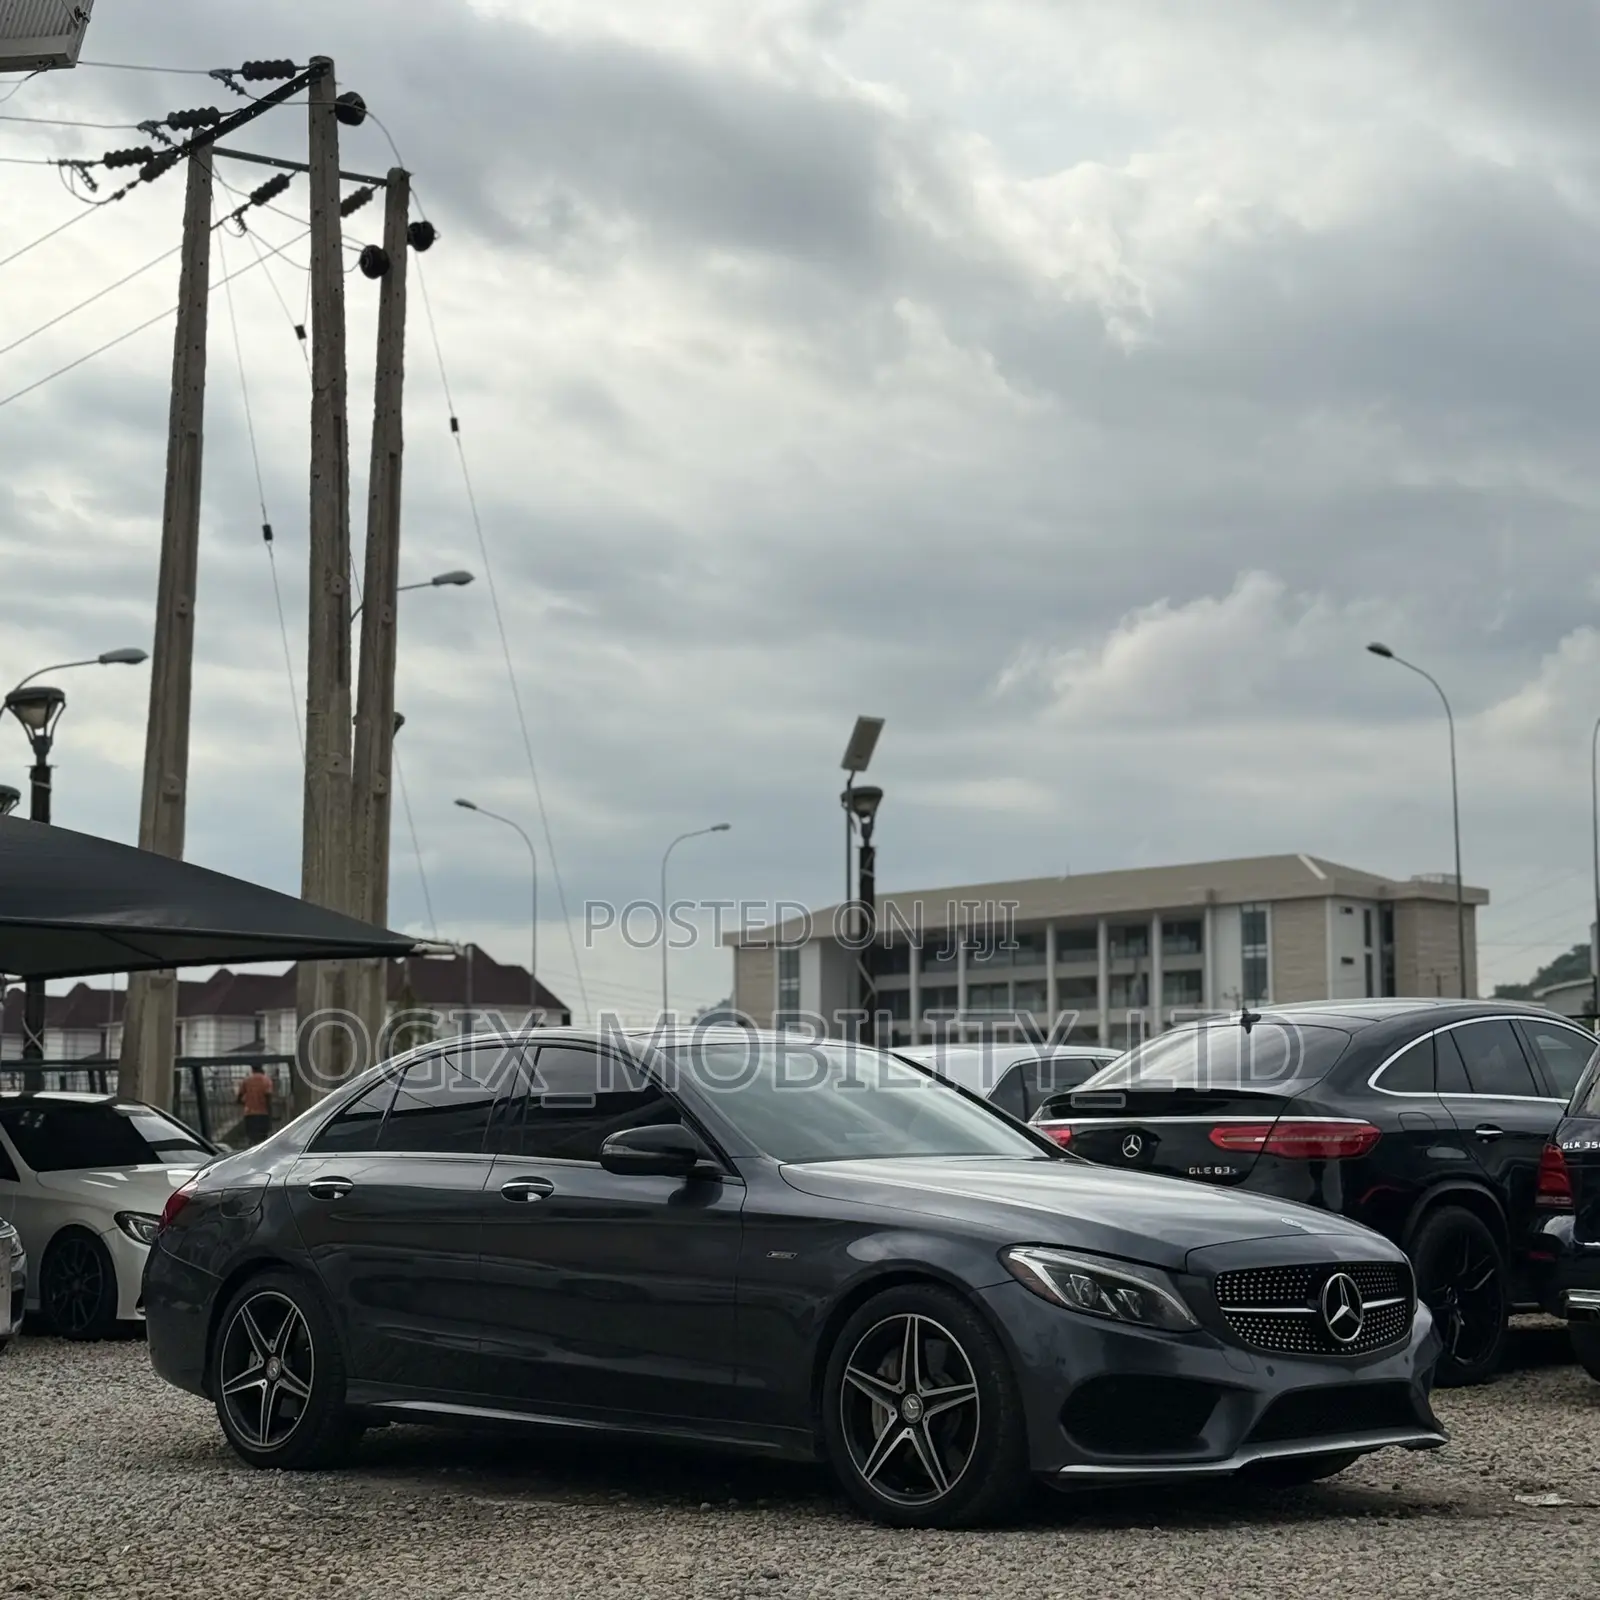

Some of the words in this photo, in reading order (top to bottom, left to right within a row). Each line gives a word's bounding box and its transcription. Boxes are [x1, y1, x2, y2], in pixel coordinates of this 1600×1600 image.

[1562, 1141, 1581, 1150] GLK
[1583, 1141, 1600, 1149] 35
[1188, 1166, 1212, 1175] GLE
